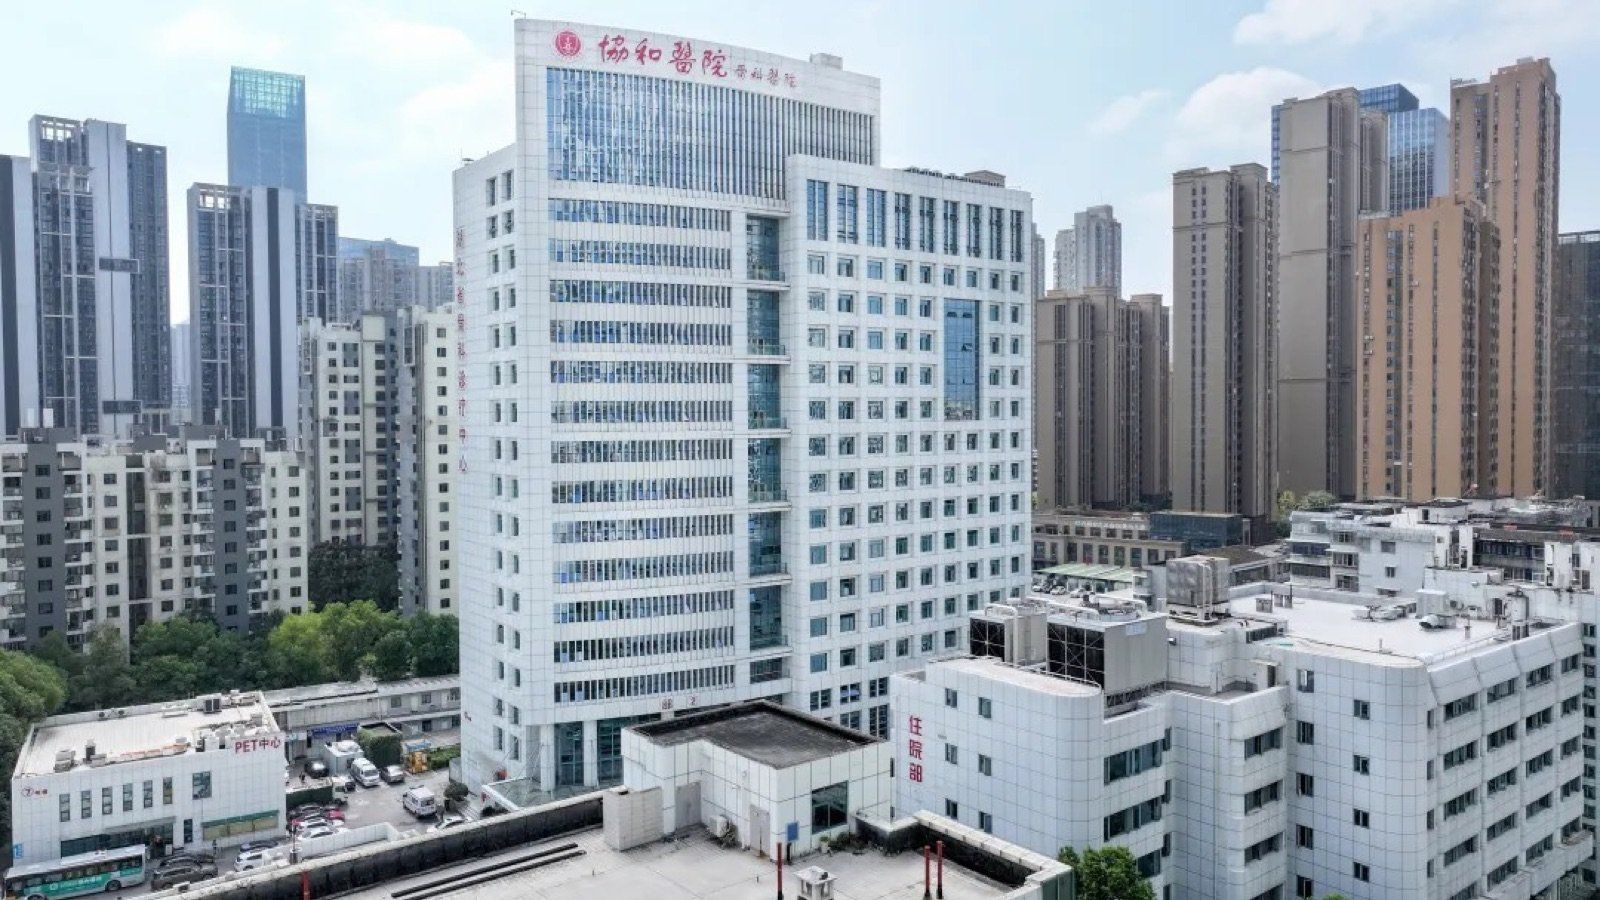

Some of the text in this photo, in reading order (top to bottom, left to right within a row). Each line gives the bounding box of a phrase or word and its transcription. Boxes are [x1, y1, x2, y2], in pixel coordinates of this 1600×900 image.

[598, 34, 728, 78] 協和醫院
[235, 737, 281, 754] PET中心
[908, 715, 922, 783] 住院部
